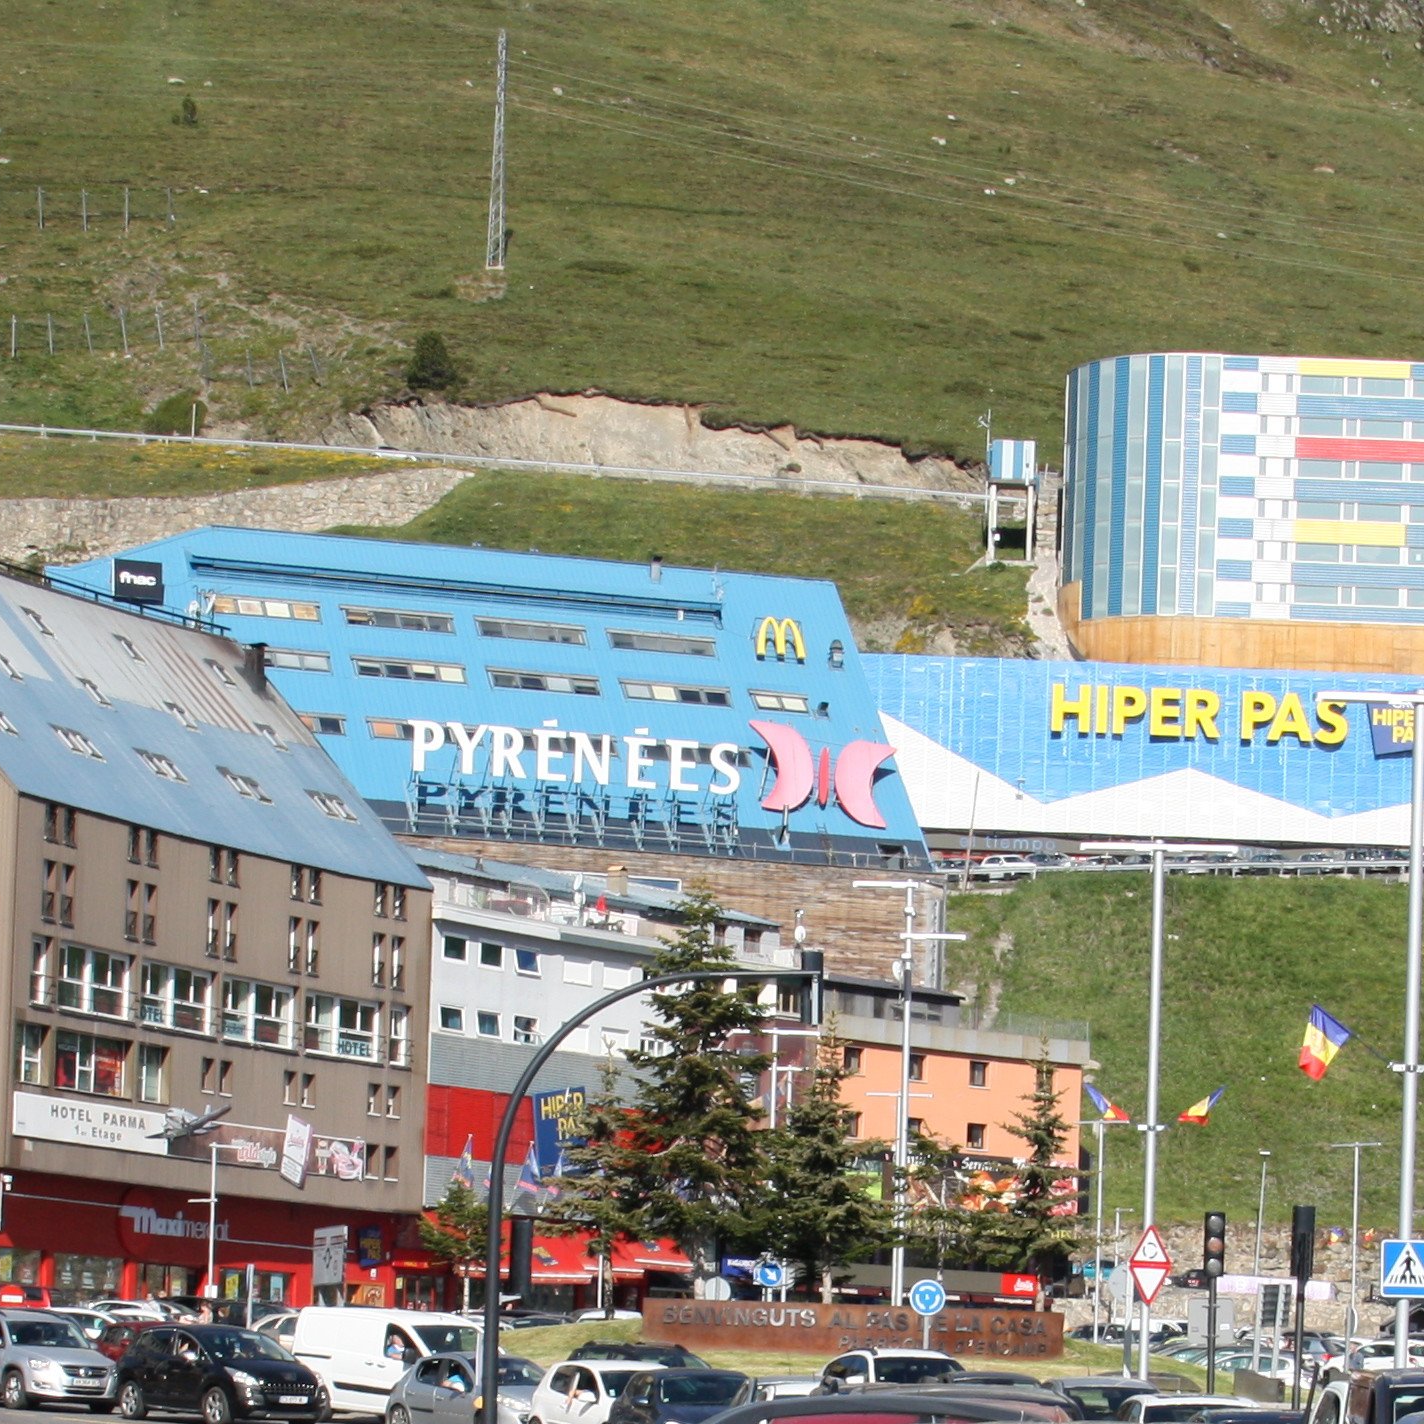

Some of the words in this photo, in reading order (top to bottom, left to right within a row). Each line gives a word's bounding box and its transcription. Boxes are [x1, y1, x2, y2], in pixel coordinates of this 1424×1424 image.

[119, 571, 157, 587] fnac
[1051, 684, 1221, 741] HIPER
[1241, 691, 1349, 745] PAS
[1373, 708, 1414, 728] HIPE
[1393, 726, 1416, 744] PA
[408, 719, 741, 797] PYRÉNÉES
[986, 836, 1056, 850] tiempo
[338, 1039, 372, 1057] HOTEL
[51, 1105, 92, 1123] HOTEL
[103, 1112, 146, 1130] PARMA
[91, 1126, 122, 1142] Etage
[663, 1307, 816, 1328] BENVINGUTS
[828, 1311, 858, 1329] AL
[866, 1311, 909, 1331] PAS
[956, 1314, 984, 1333] LA
[991, 1316, 1047, 1337] CASA
